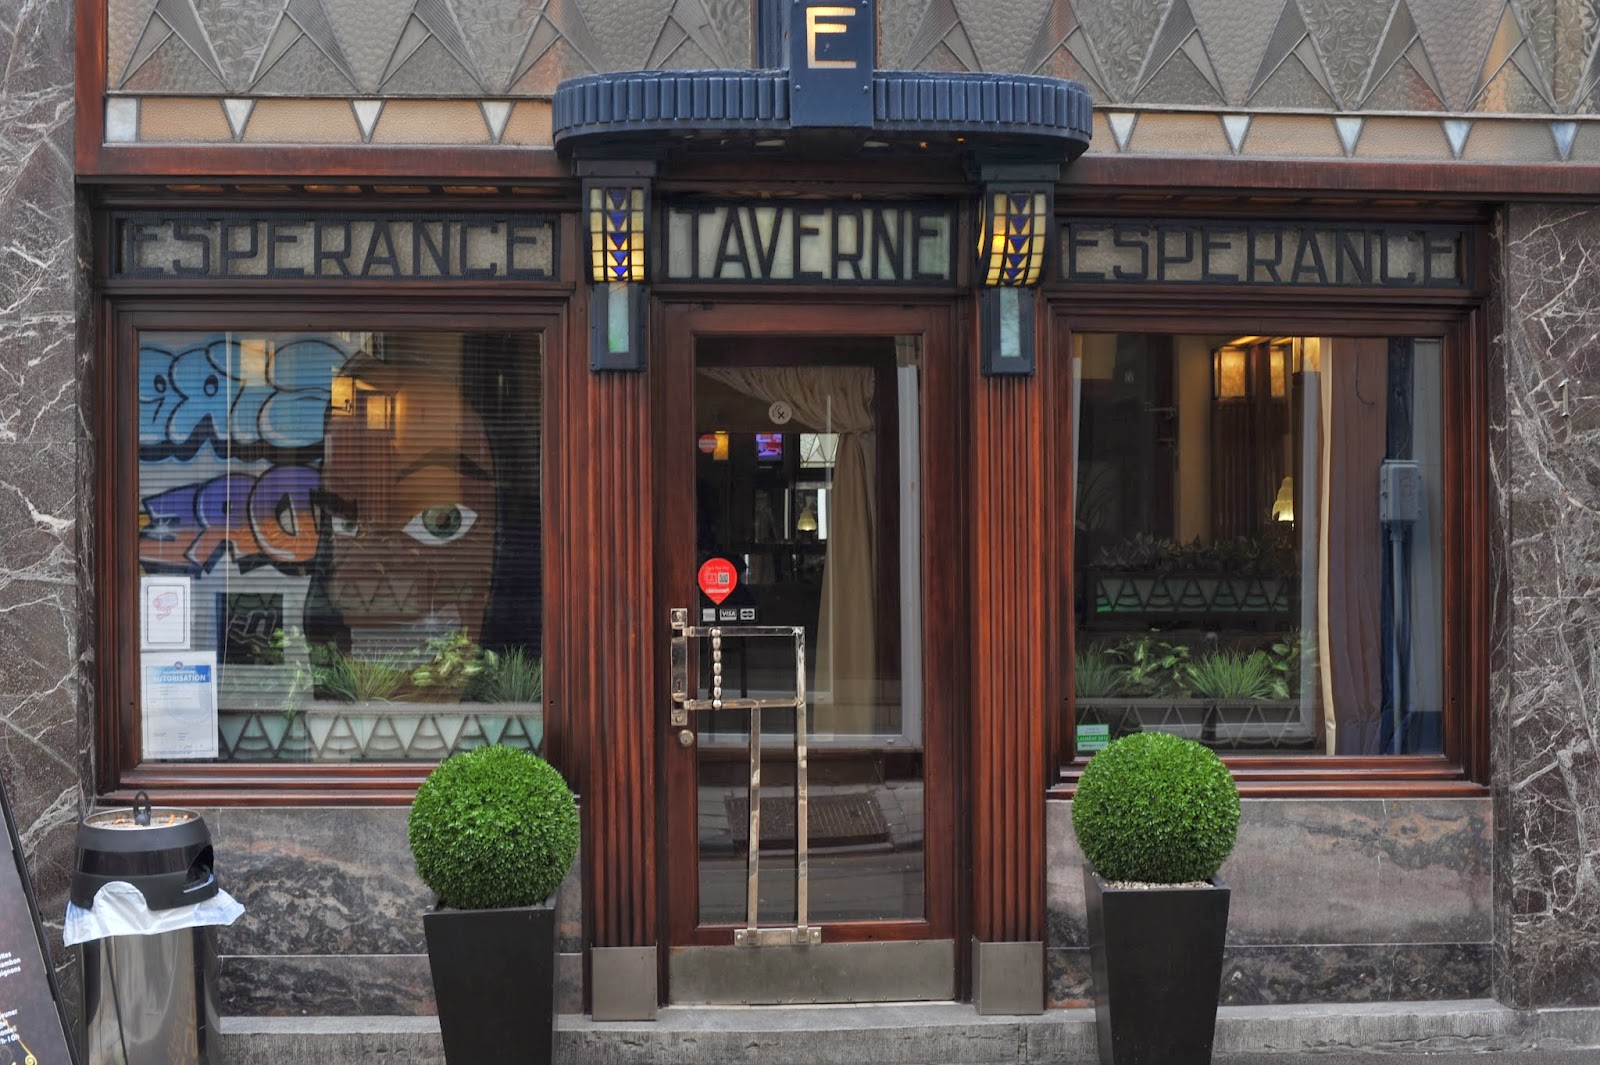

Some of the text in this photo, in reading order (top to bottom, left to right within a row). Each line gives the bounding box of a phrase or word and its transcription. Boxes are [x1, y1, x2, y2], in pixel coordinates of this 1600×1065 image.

[805, 5, 858, 70] E
[128, 217, 547, 277] ESPERANCE
[676, 204, 947, 281] TAVERNE
[1069, 224, 1459, 284] ESPERANCE
